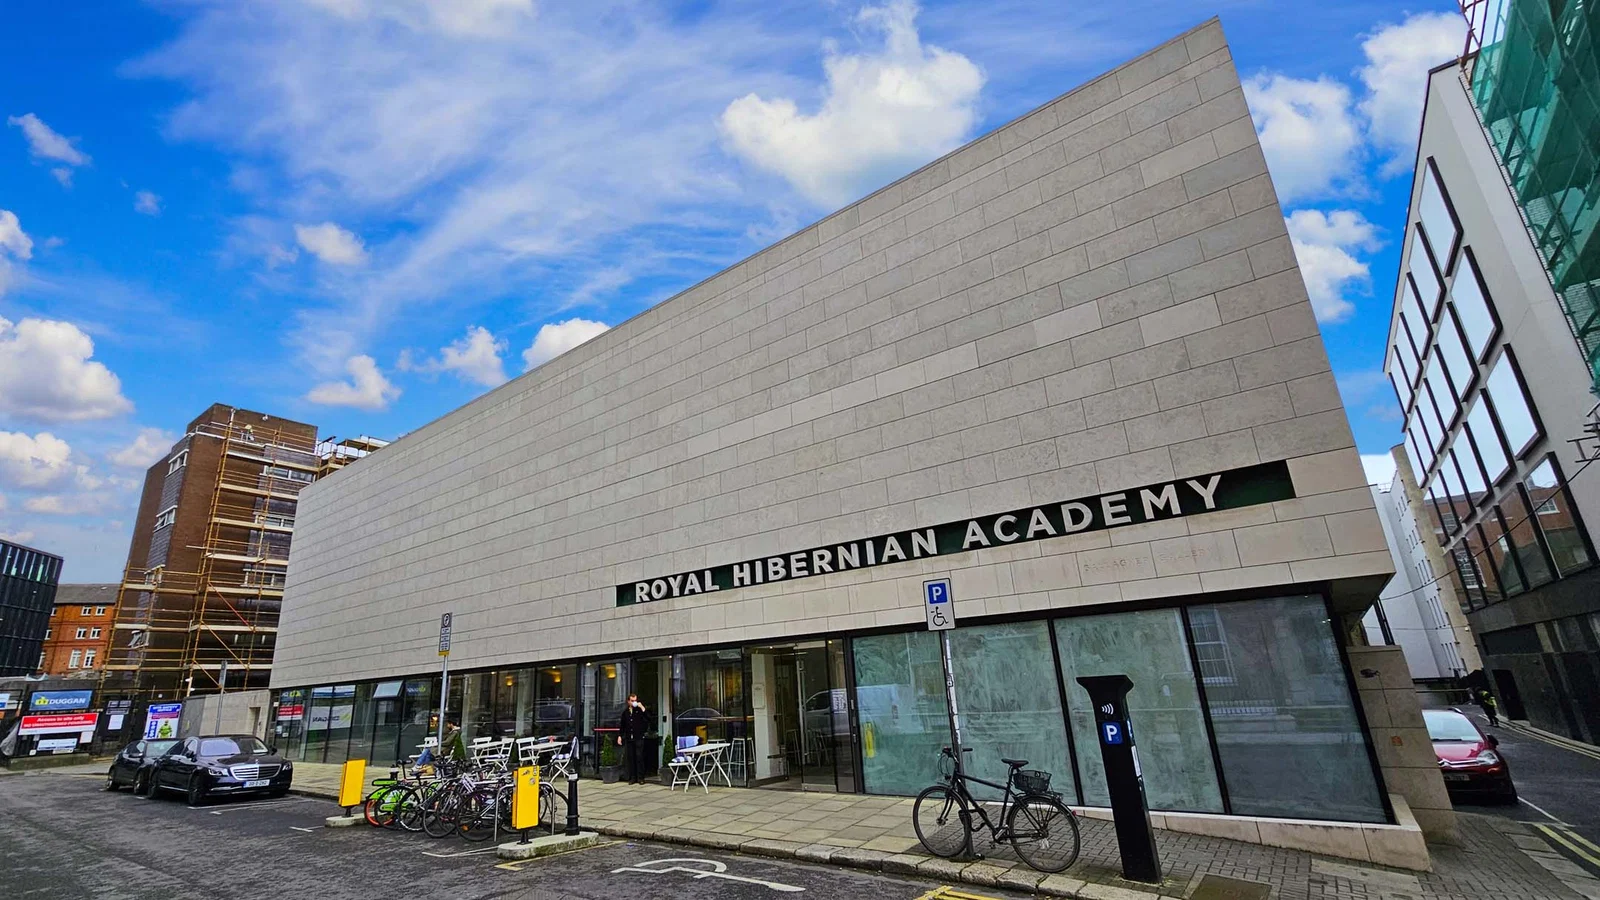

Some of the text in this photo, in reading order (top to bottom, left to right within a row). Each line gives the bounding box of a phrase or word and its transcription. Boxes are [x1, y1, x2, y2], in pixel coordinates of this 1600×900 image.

[635, 474, 1222, 603] ROYAL HIBERNIAN ACADEMY
[932, 586, 942, 601] P
[49, 697, 86, 705] DUGGAN
[1106, 724, 1117, 742] P
